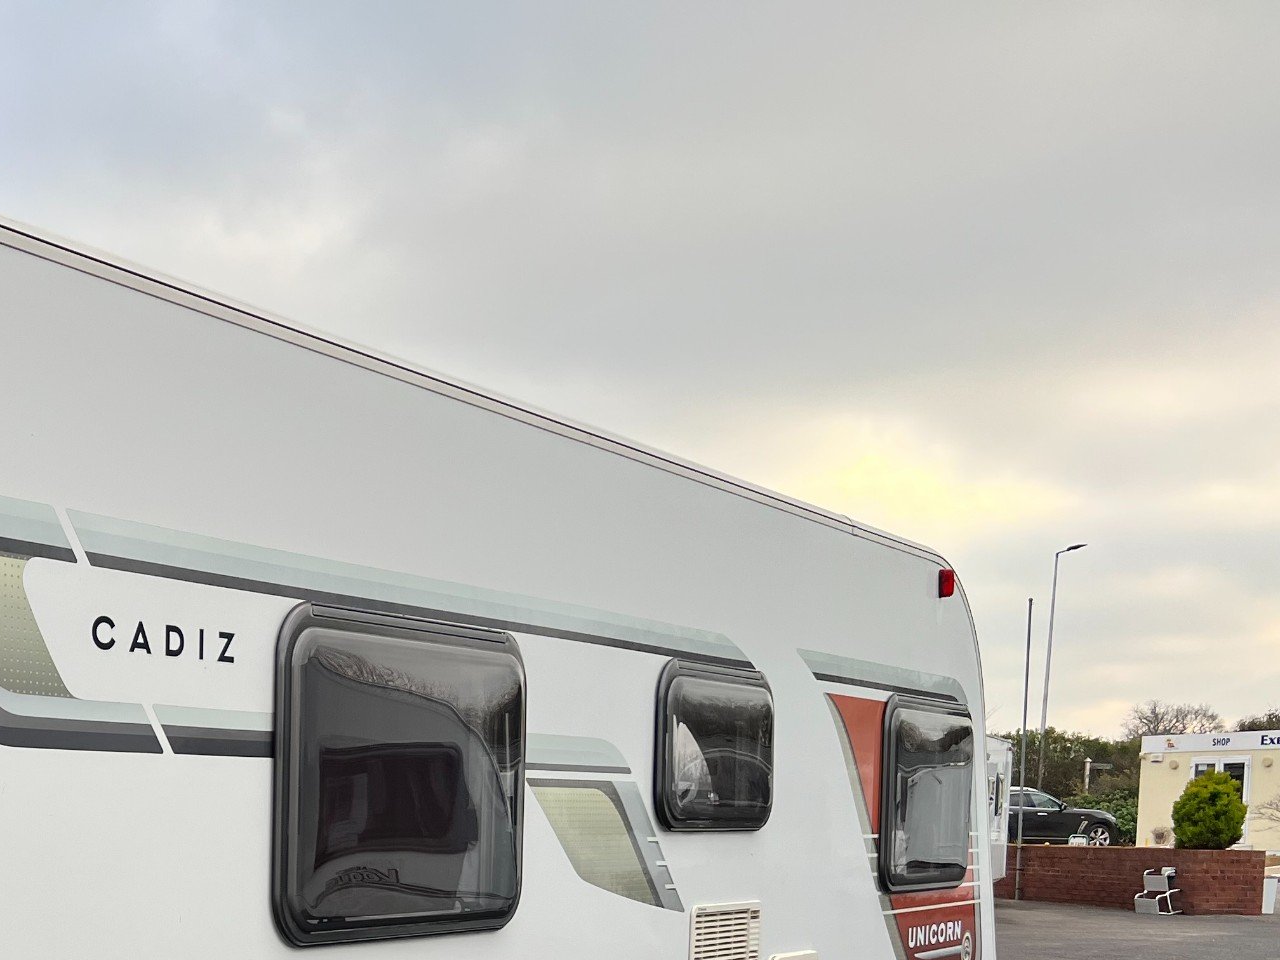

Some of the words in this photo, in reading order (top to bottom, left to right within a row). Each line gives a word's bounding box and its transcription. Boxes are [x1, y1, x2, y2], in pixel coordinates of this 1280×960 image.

[91, 615, 236, 664] CADIZ
[1212, 737, 1231, 747] SHOP
[908, 920, 962, 949] UNICORN
